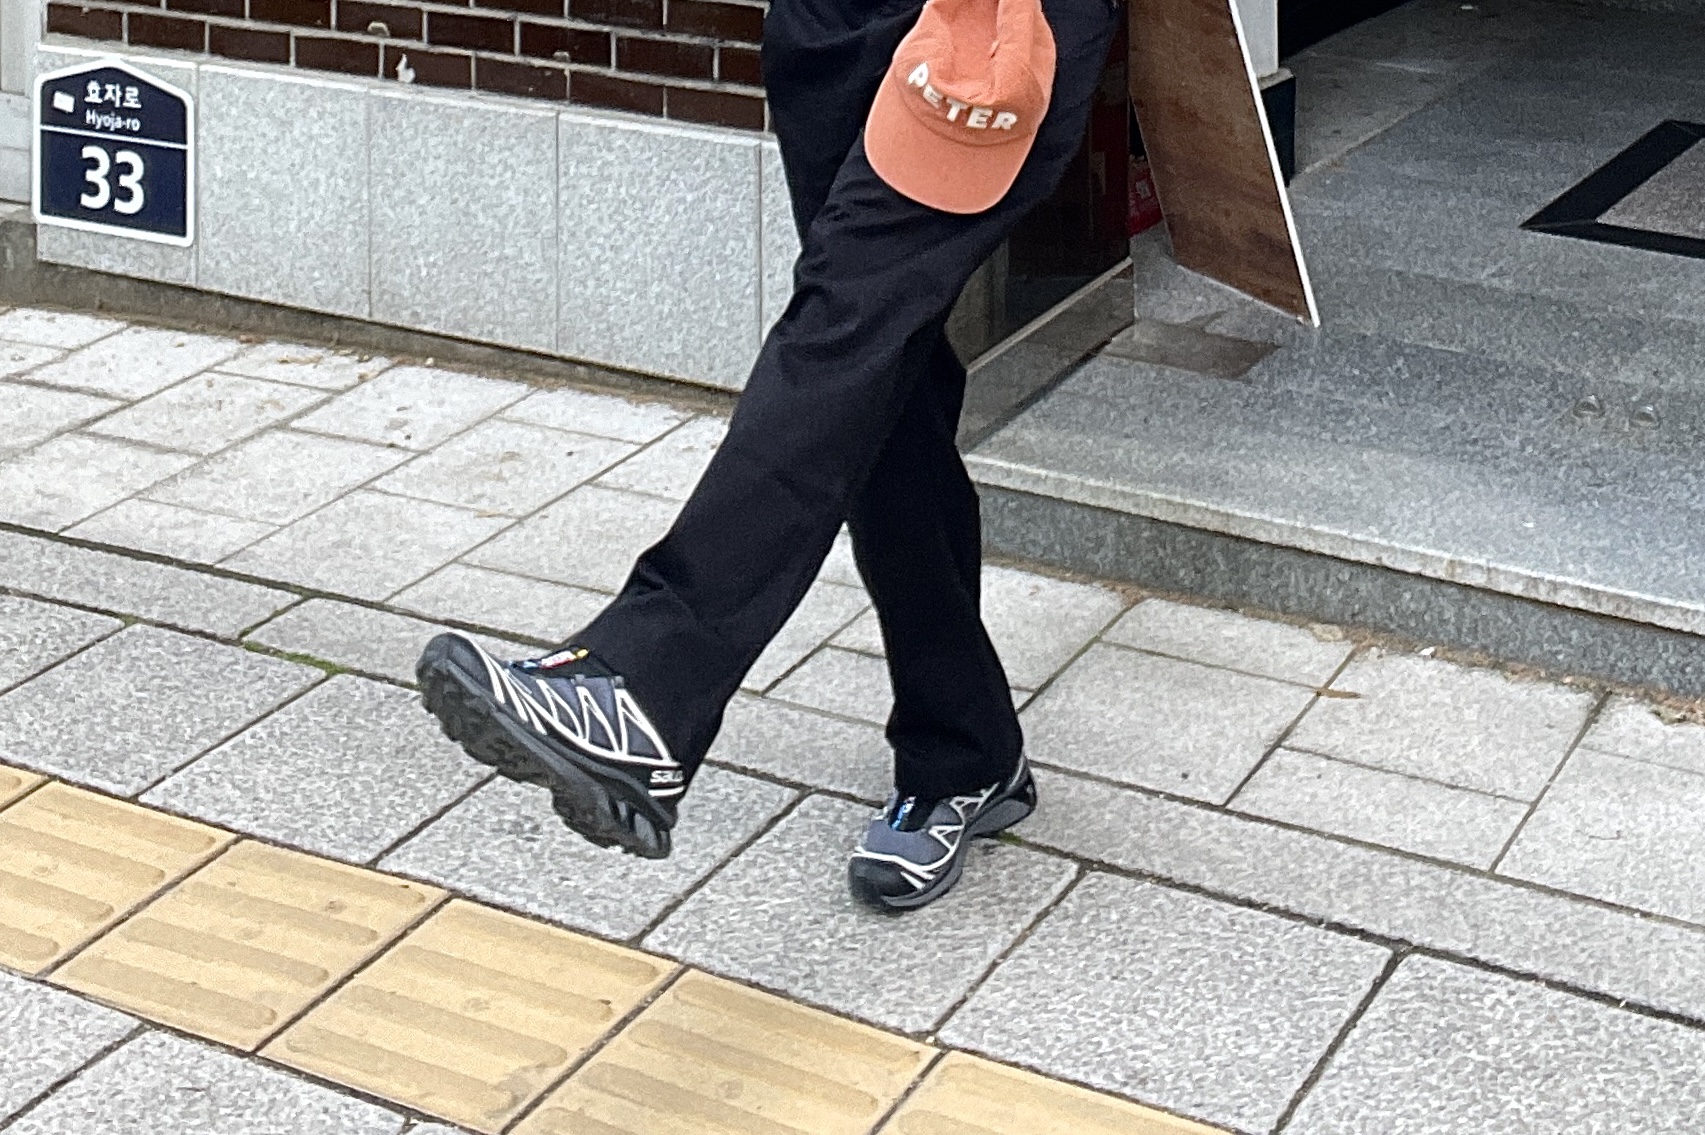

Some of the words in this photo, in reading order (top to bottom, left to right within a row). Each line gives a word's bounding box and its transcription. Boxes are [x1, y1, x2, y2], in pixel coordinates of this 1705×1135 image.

[83, 79, 142, 109] 효자로
[907, 63, 1018, 131] PETER
[85, 109, 141, 132] Hyoja-ro
[80, 145, 145, 214] 33
